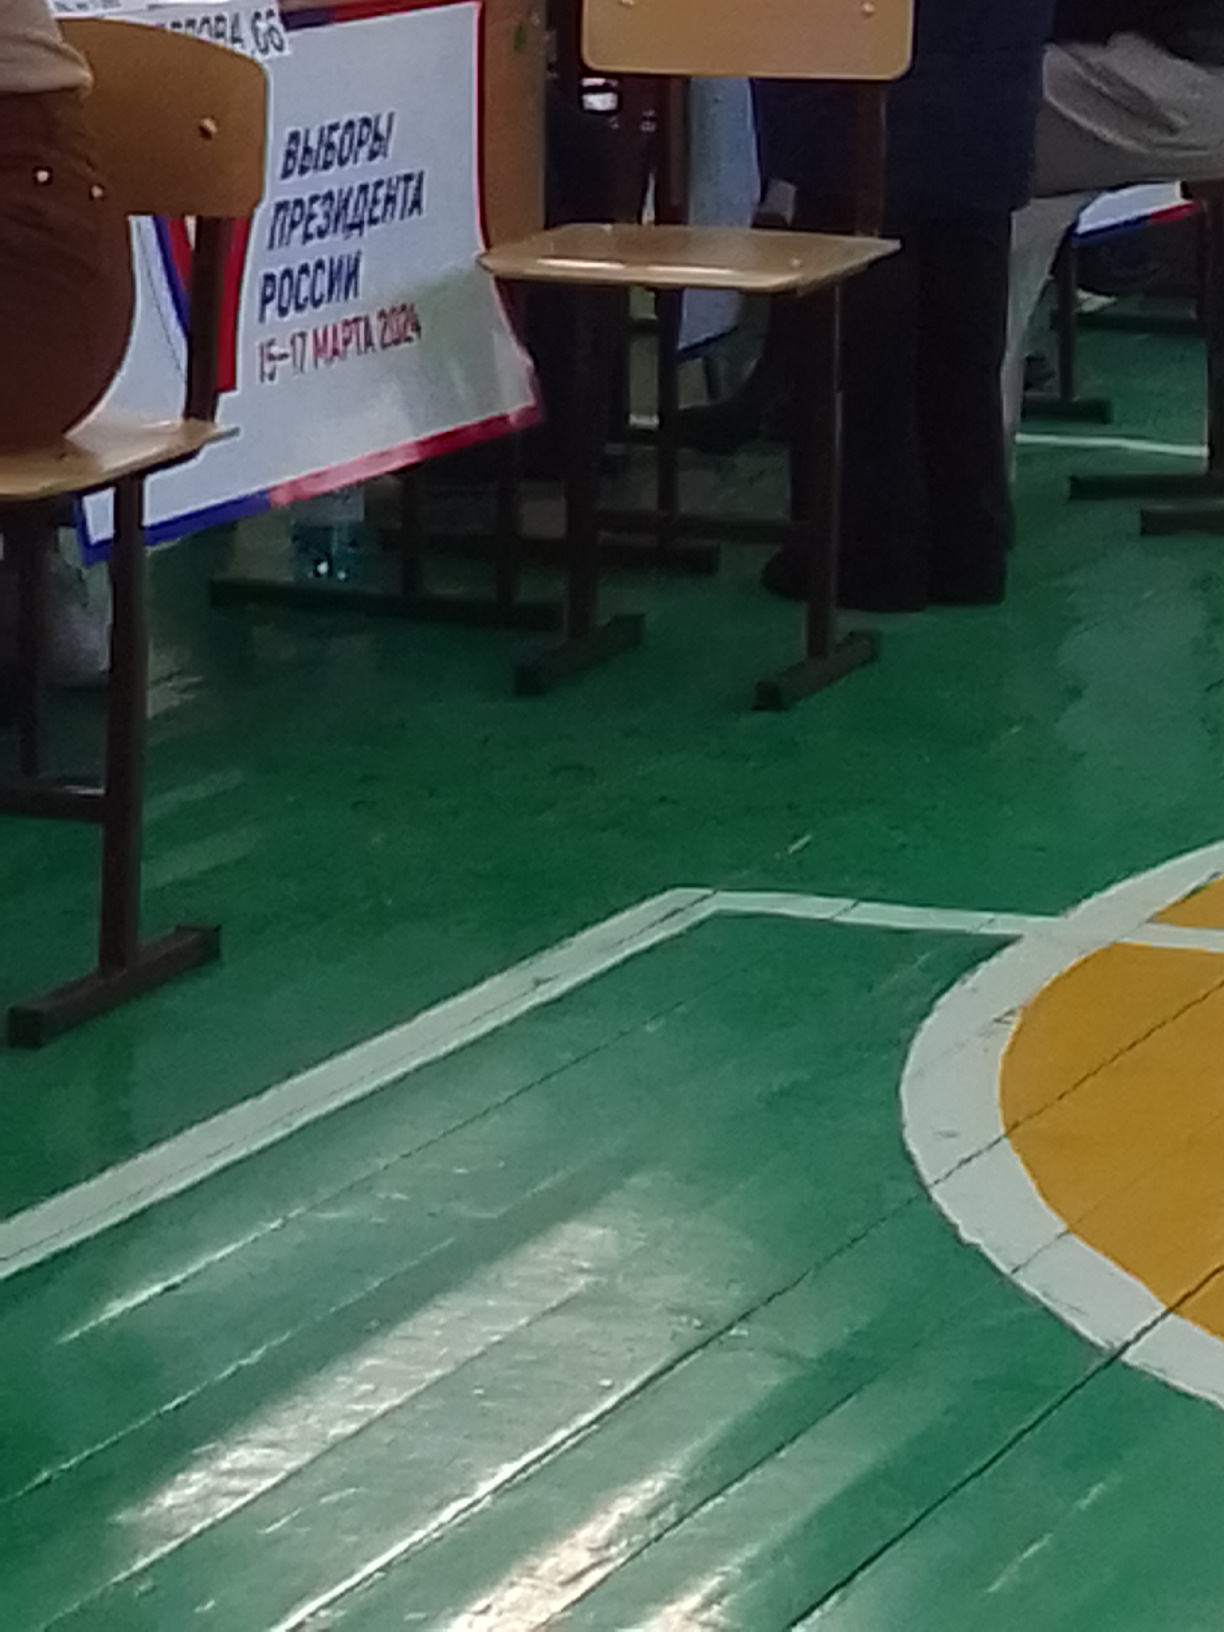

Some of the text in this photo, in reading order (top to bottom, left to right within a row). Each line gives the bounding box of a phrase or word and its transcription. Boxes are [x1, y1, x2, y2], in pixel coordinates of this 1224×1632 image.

[279, 111, 396, 182] ВЫБОРЫ
[267, 170, 425, 250] ПРЕЗИДЕНТА
[257, 250, 362, 324] РОССИИ
[311, 314, 377, 369] МАРТА
